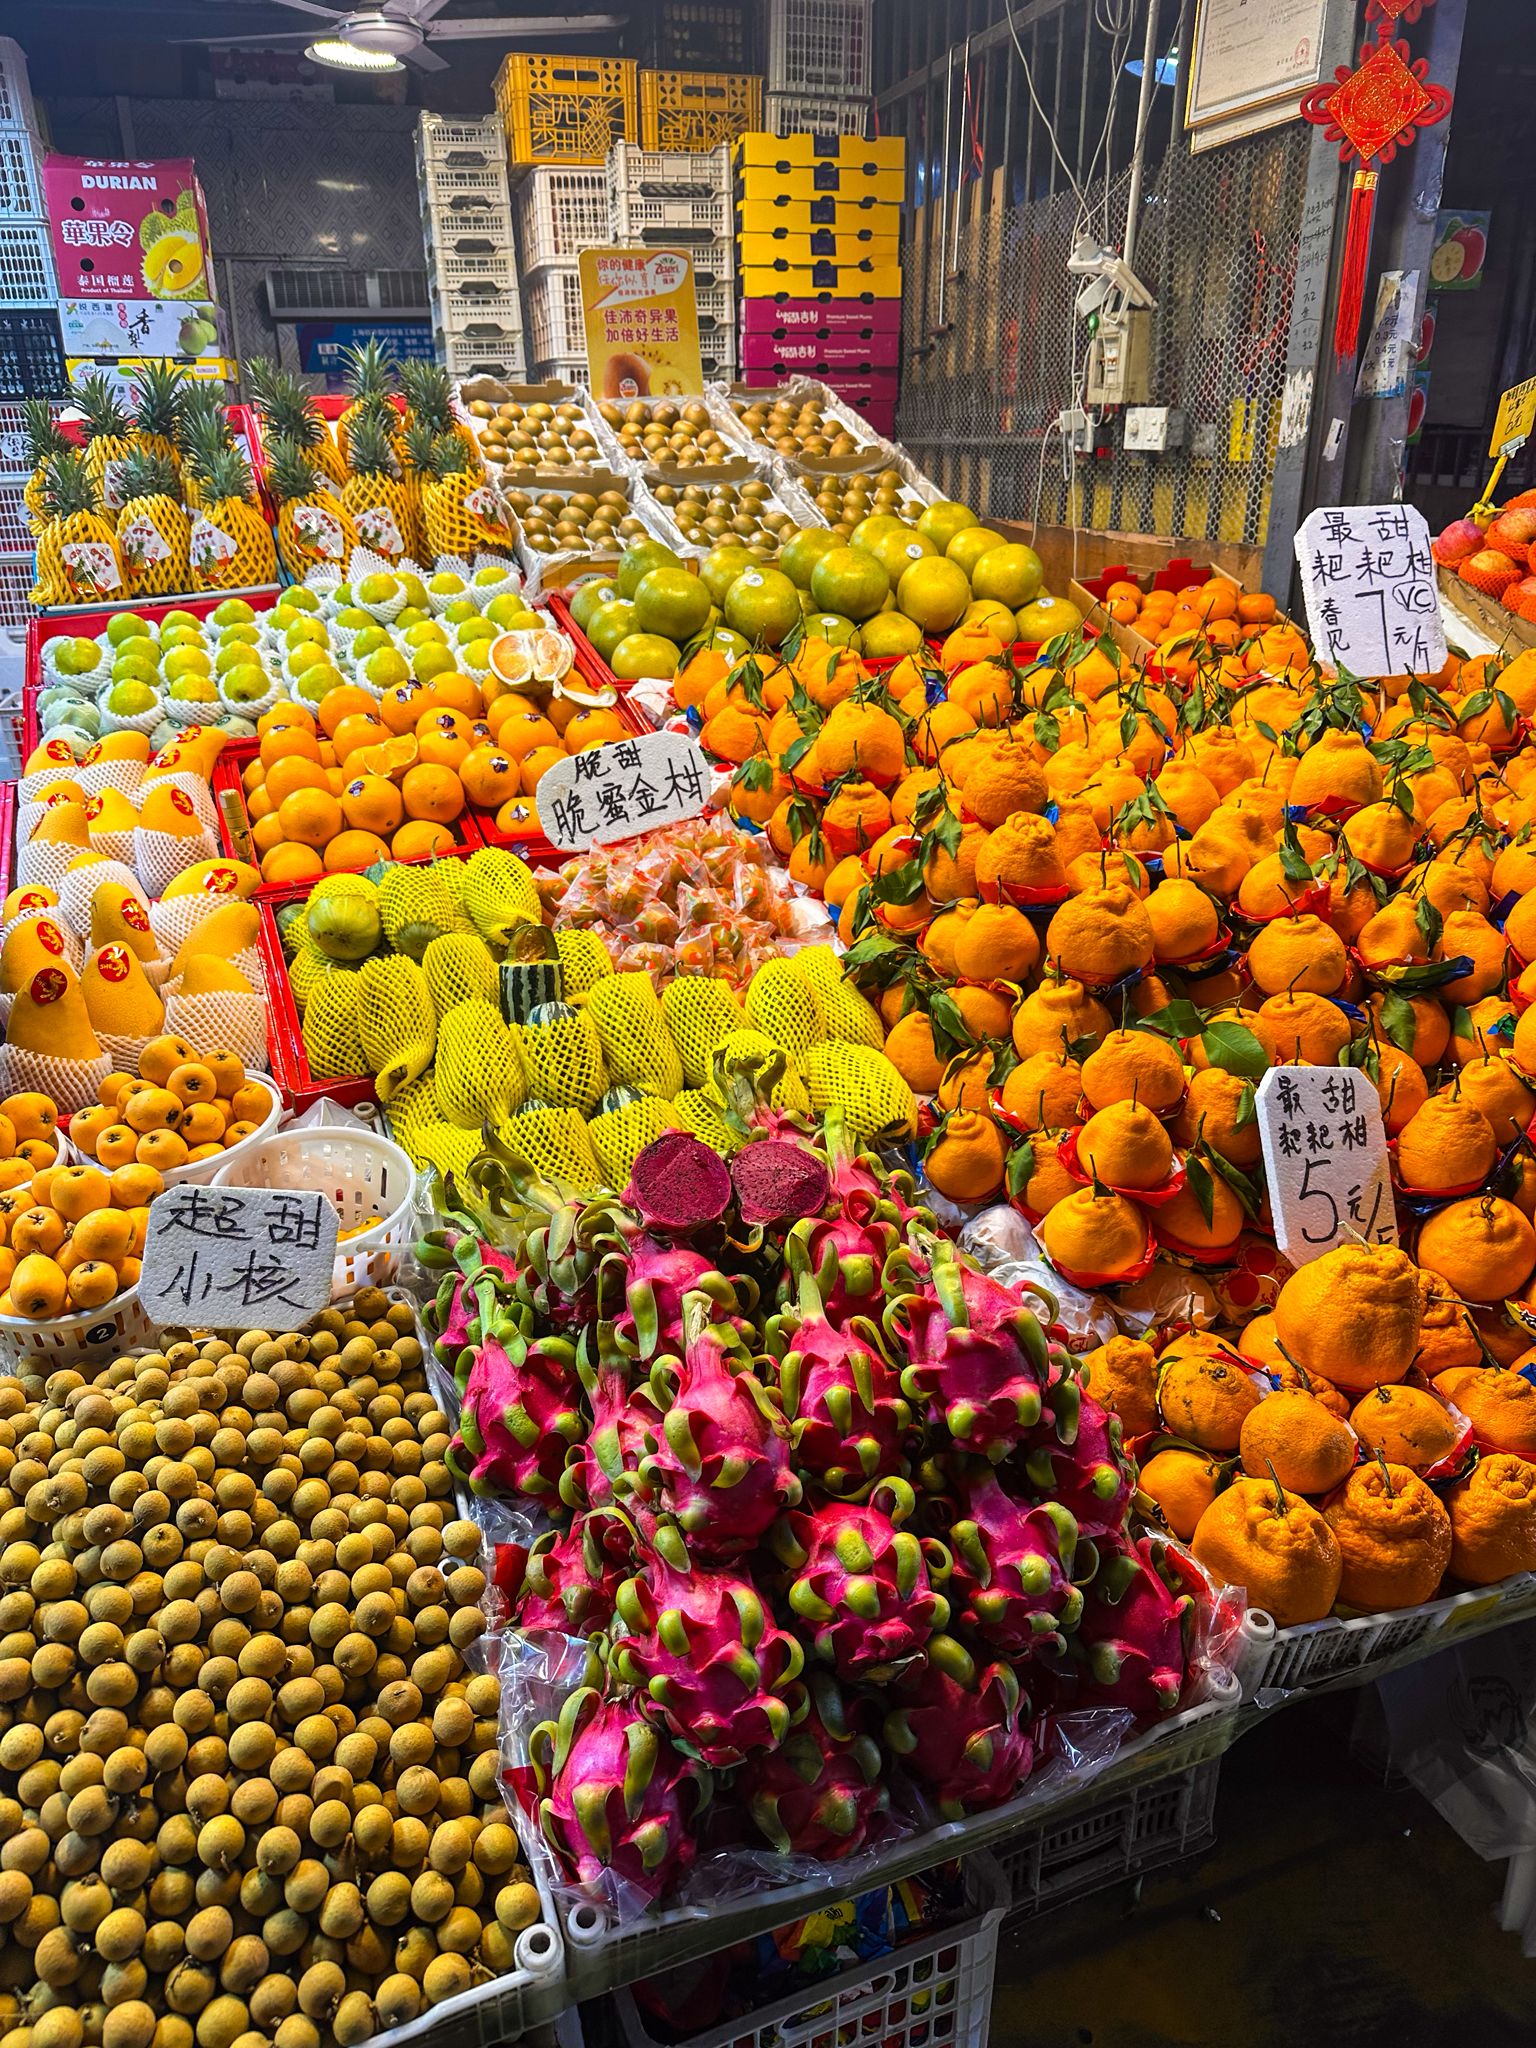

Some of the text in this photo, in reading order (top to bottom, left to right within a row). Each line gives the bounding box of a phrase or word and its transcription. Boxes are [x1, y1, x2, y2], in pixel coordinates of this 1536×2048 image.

[81, 175, 158, 190] DURIAN
[597, 258, 647, 271] 你的健康
[604, 308, 679, 325] 佳沛奇异果
[605, 327, 679, 343] 加倍好生活
[1320, 506, 1410, 549] 最甜
[1312, 534, 1433, 587] 耙耙柑
[1397, 585, 1432, 611] VC
[1320, 597, 1351, 651] 春见
[575, 740, 643, 784] 脆甜
[551, 748, 703, 846] 脆蜜金柑
[1276, 1075, 1356, 1120] 最甜
[1278, 1115, 1368, 1158] 耙耙柑
[157, 1189, 323, 1250] 超甜
[157, 1250, 313, 1310] 小核
[96, 1327, 110, 1340] 2
